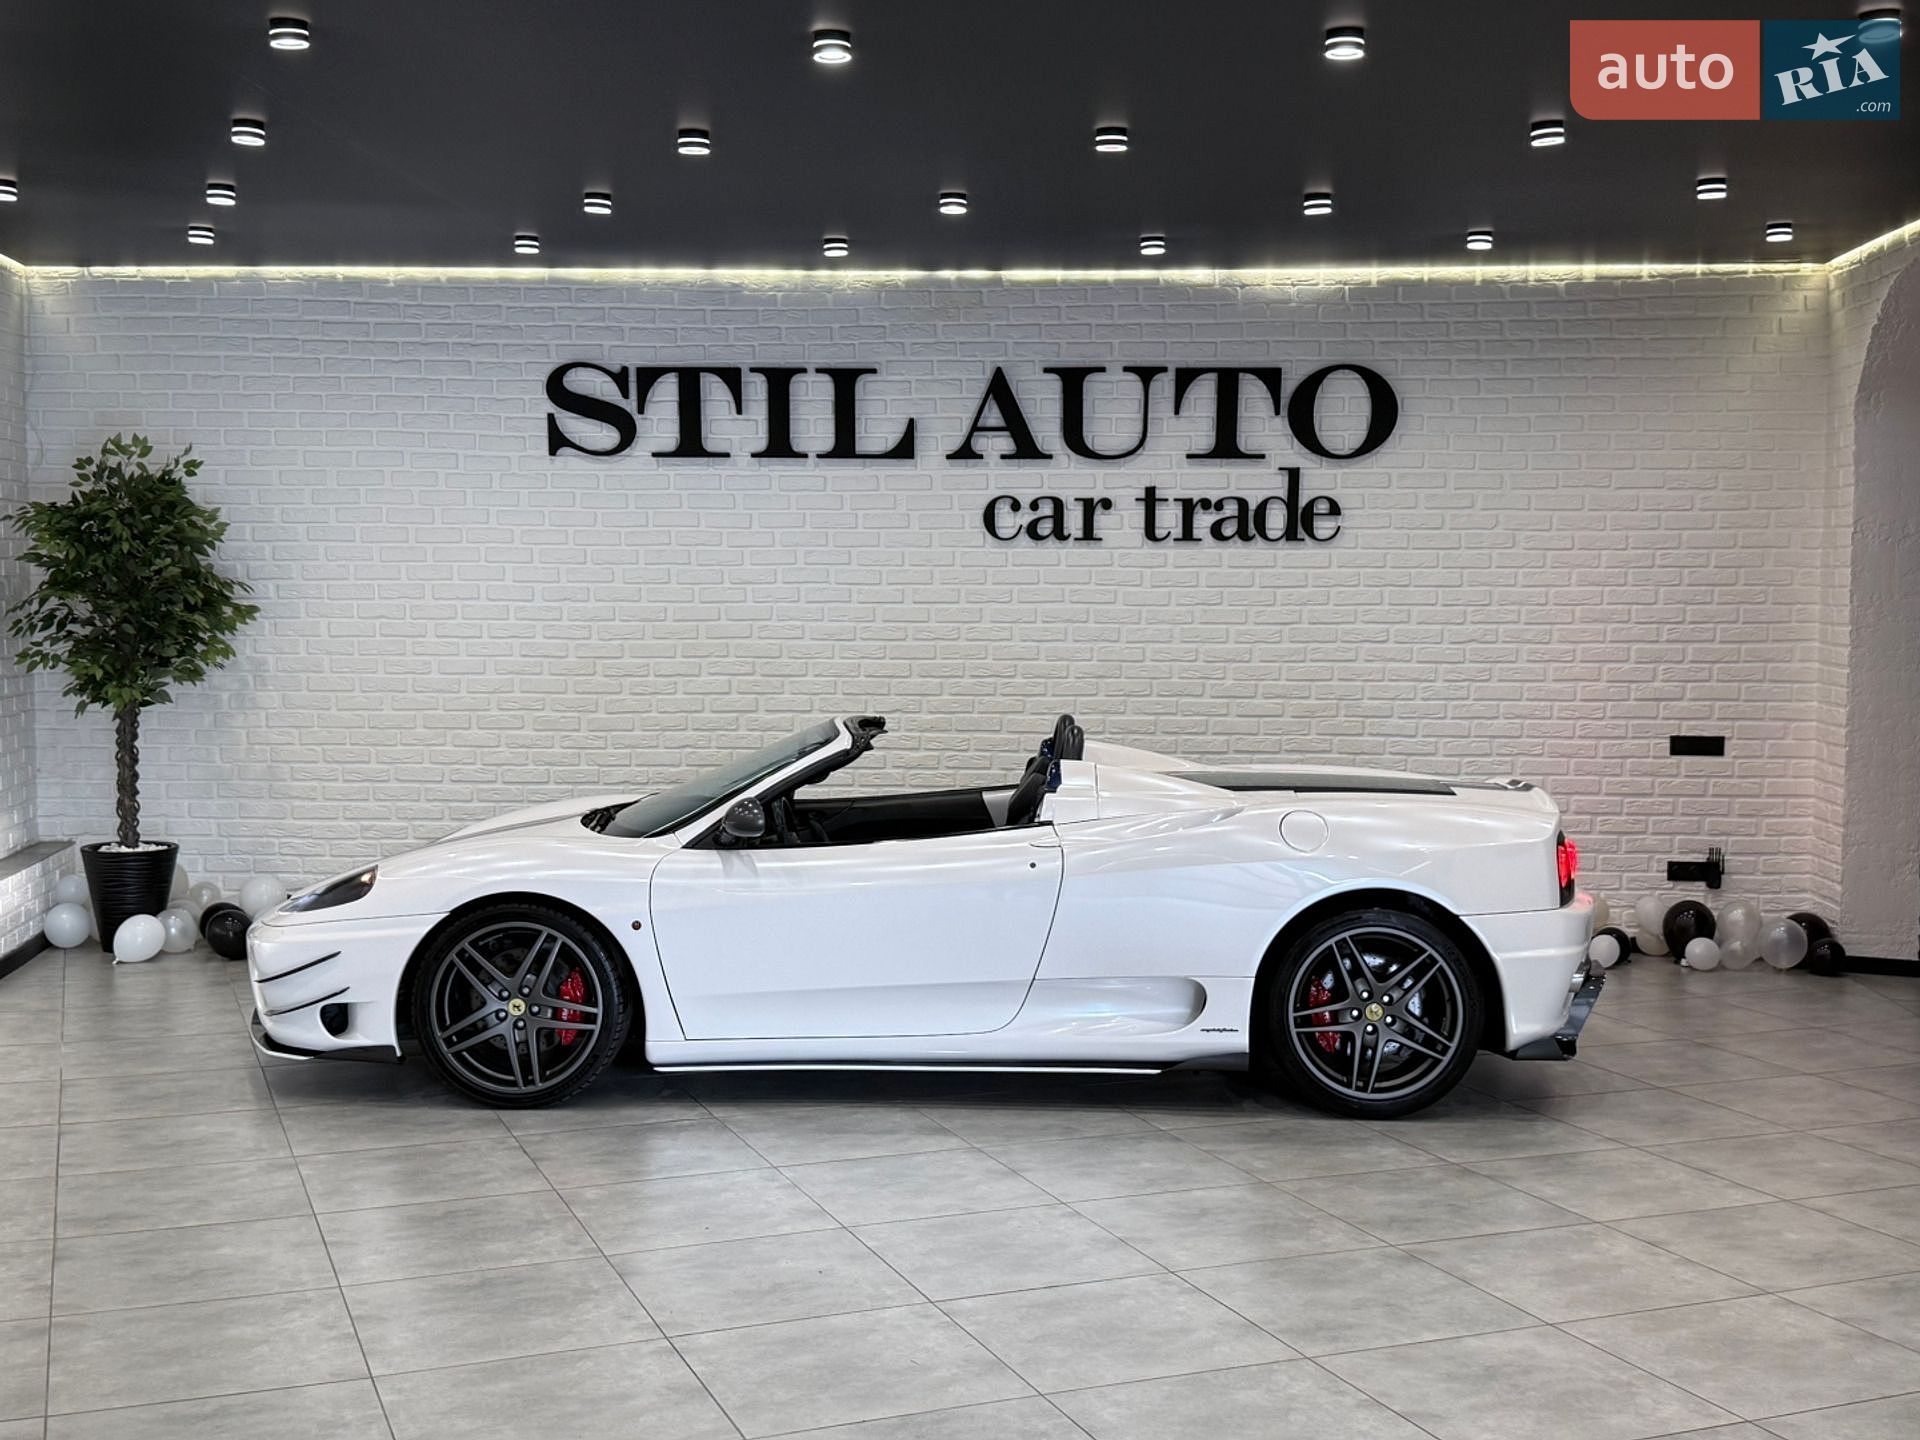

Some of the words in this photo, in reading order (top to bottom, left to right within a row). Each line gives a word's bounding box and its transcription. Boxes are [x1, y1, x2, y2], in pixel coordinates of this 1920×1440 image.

[546, 362, 914, 459] STIL
[946, 363, 1398, 460] AUTO
[983, 495, 1112, 541] car
[1135, 467, 1341, 542] trade
